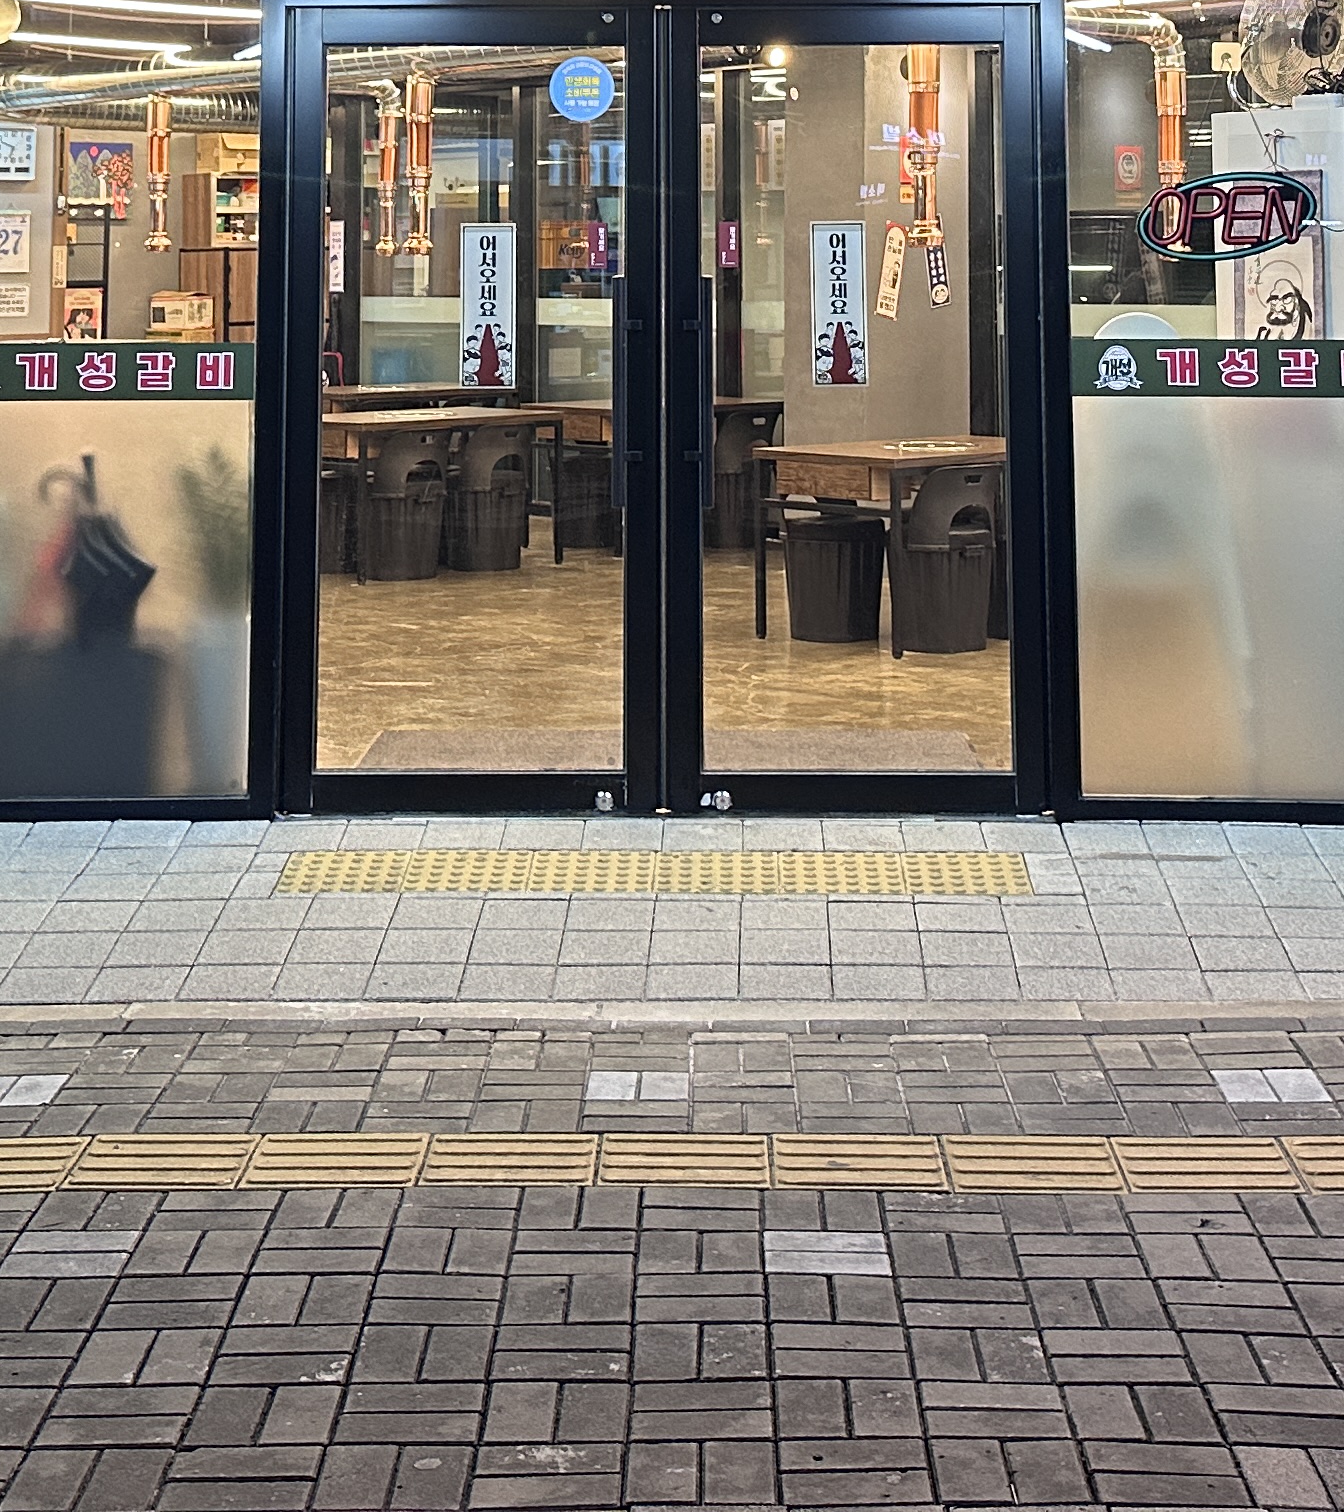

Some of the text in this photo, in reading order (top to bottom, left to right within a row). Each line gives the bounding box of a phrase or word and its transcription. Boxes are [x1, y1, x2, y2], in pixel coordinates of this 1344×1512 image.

[1148, 186, 1304, 246] OPEN
[479, 234, 498, 317] 어서오세요
[828, 232, 848, 315] 어서오세요
[16, 352, 235, 392] 개성갈비
